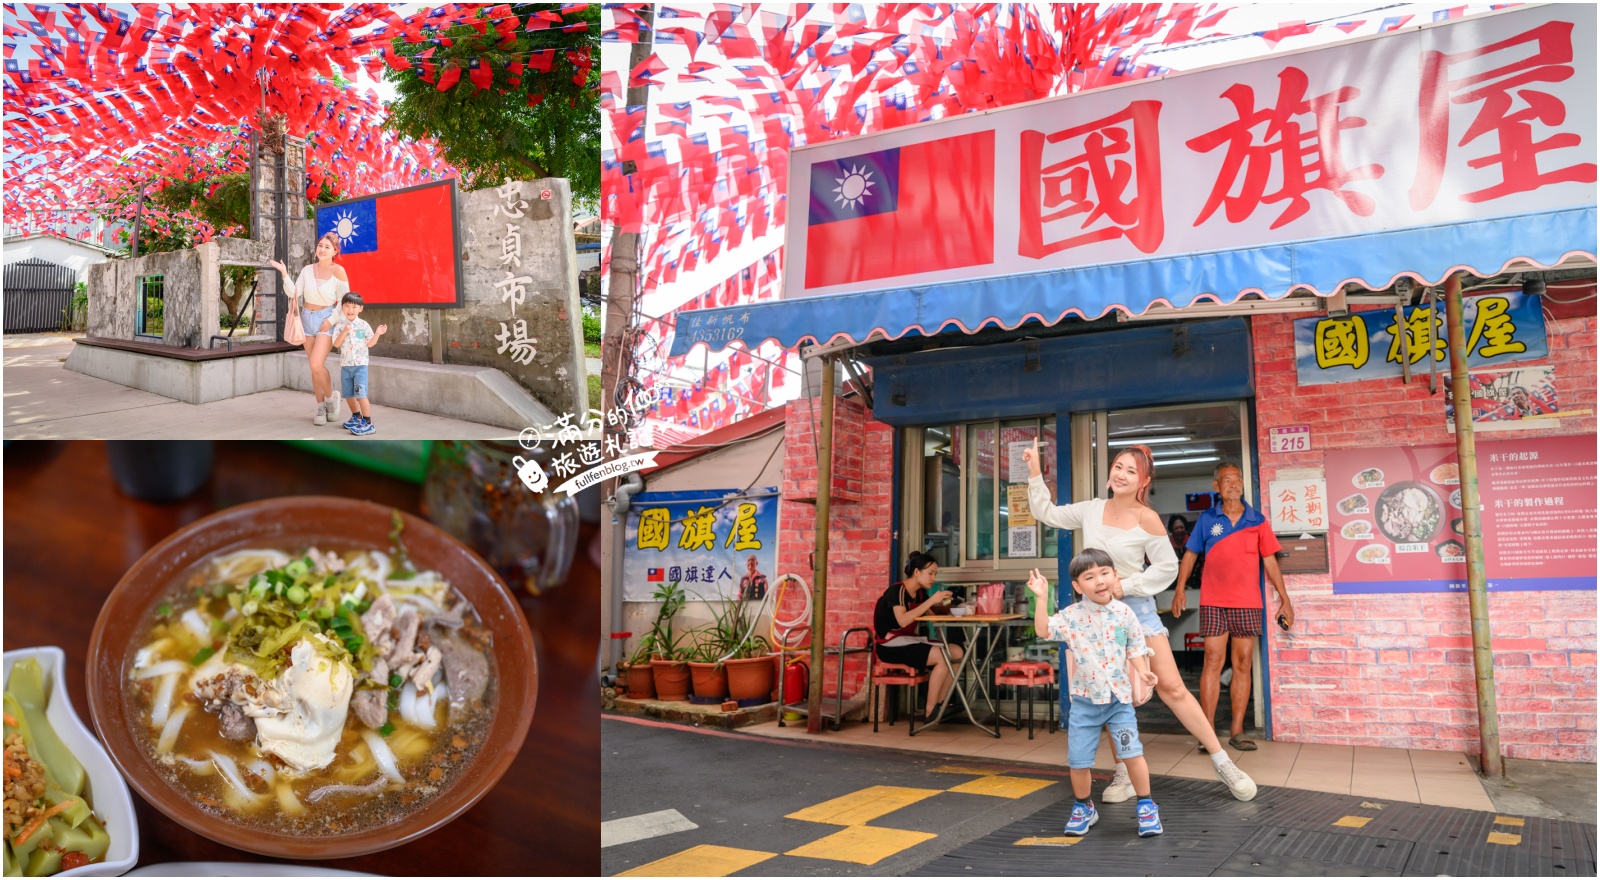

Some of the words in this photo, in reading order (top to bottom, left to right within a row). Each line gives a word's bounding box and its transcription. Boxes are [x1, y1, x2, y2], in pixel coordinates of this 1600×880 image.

[1017, 20, 1597, 259] 國旗屋
[493, 177, 538, 366] 忠貞市場
[690, 327, 745, 343] 4353162
[1314, 297, 1527, 370] 國旗屋
[1281, 436, 1305, 451] 215
[1489, 450, 1539, 463] 米干的起源
[1277, 488, 1303, 524] 公休
[1304, 484, 1323, 528] 星期四
[1494, 496, 1565, 509] 米干的製作過程
[637, 503, 762, 552] 國旗屋
[668, 565, 733, 583] 國旗達人
